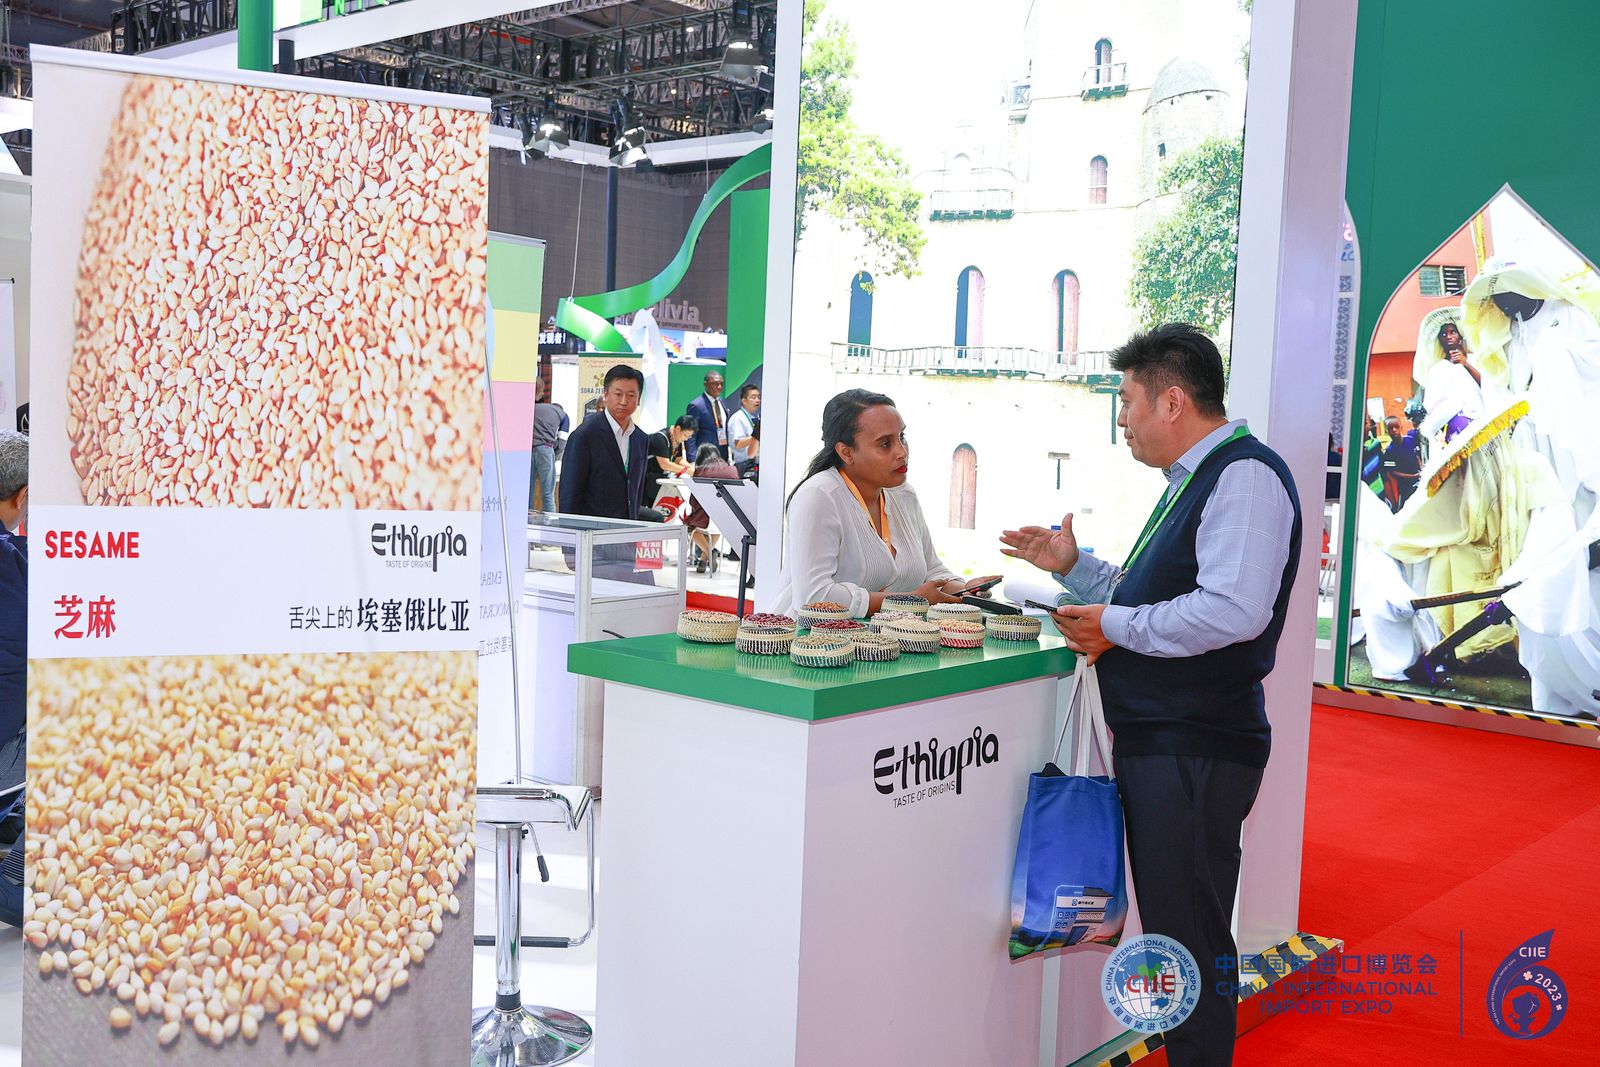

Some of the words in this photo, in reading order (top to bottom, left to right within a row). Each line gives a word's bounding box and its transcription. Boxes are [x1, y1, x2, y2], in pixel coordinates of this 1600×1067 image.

[45, 530, 140, 559] SESAME
[371, 523, 467, 572] Ethiopia
[385, 560, 402, 568] TASTE
[402, 560, 410, 568] OF
[410, 560, 433, 568] ORIGINS
[54, 595, 116, 640] 芝麻
[873, 726, 999, 795] Ethiopia
[893, 792, 916, 809] TASTE
[916, 788, 927, 801] OF
[927, 780, 956, 798] ORIGINS
